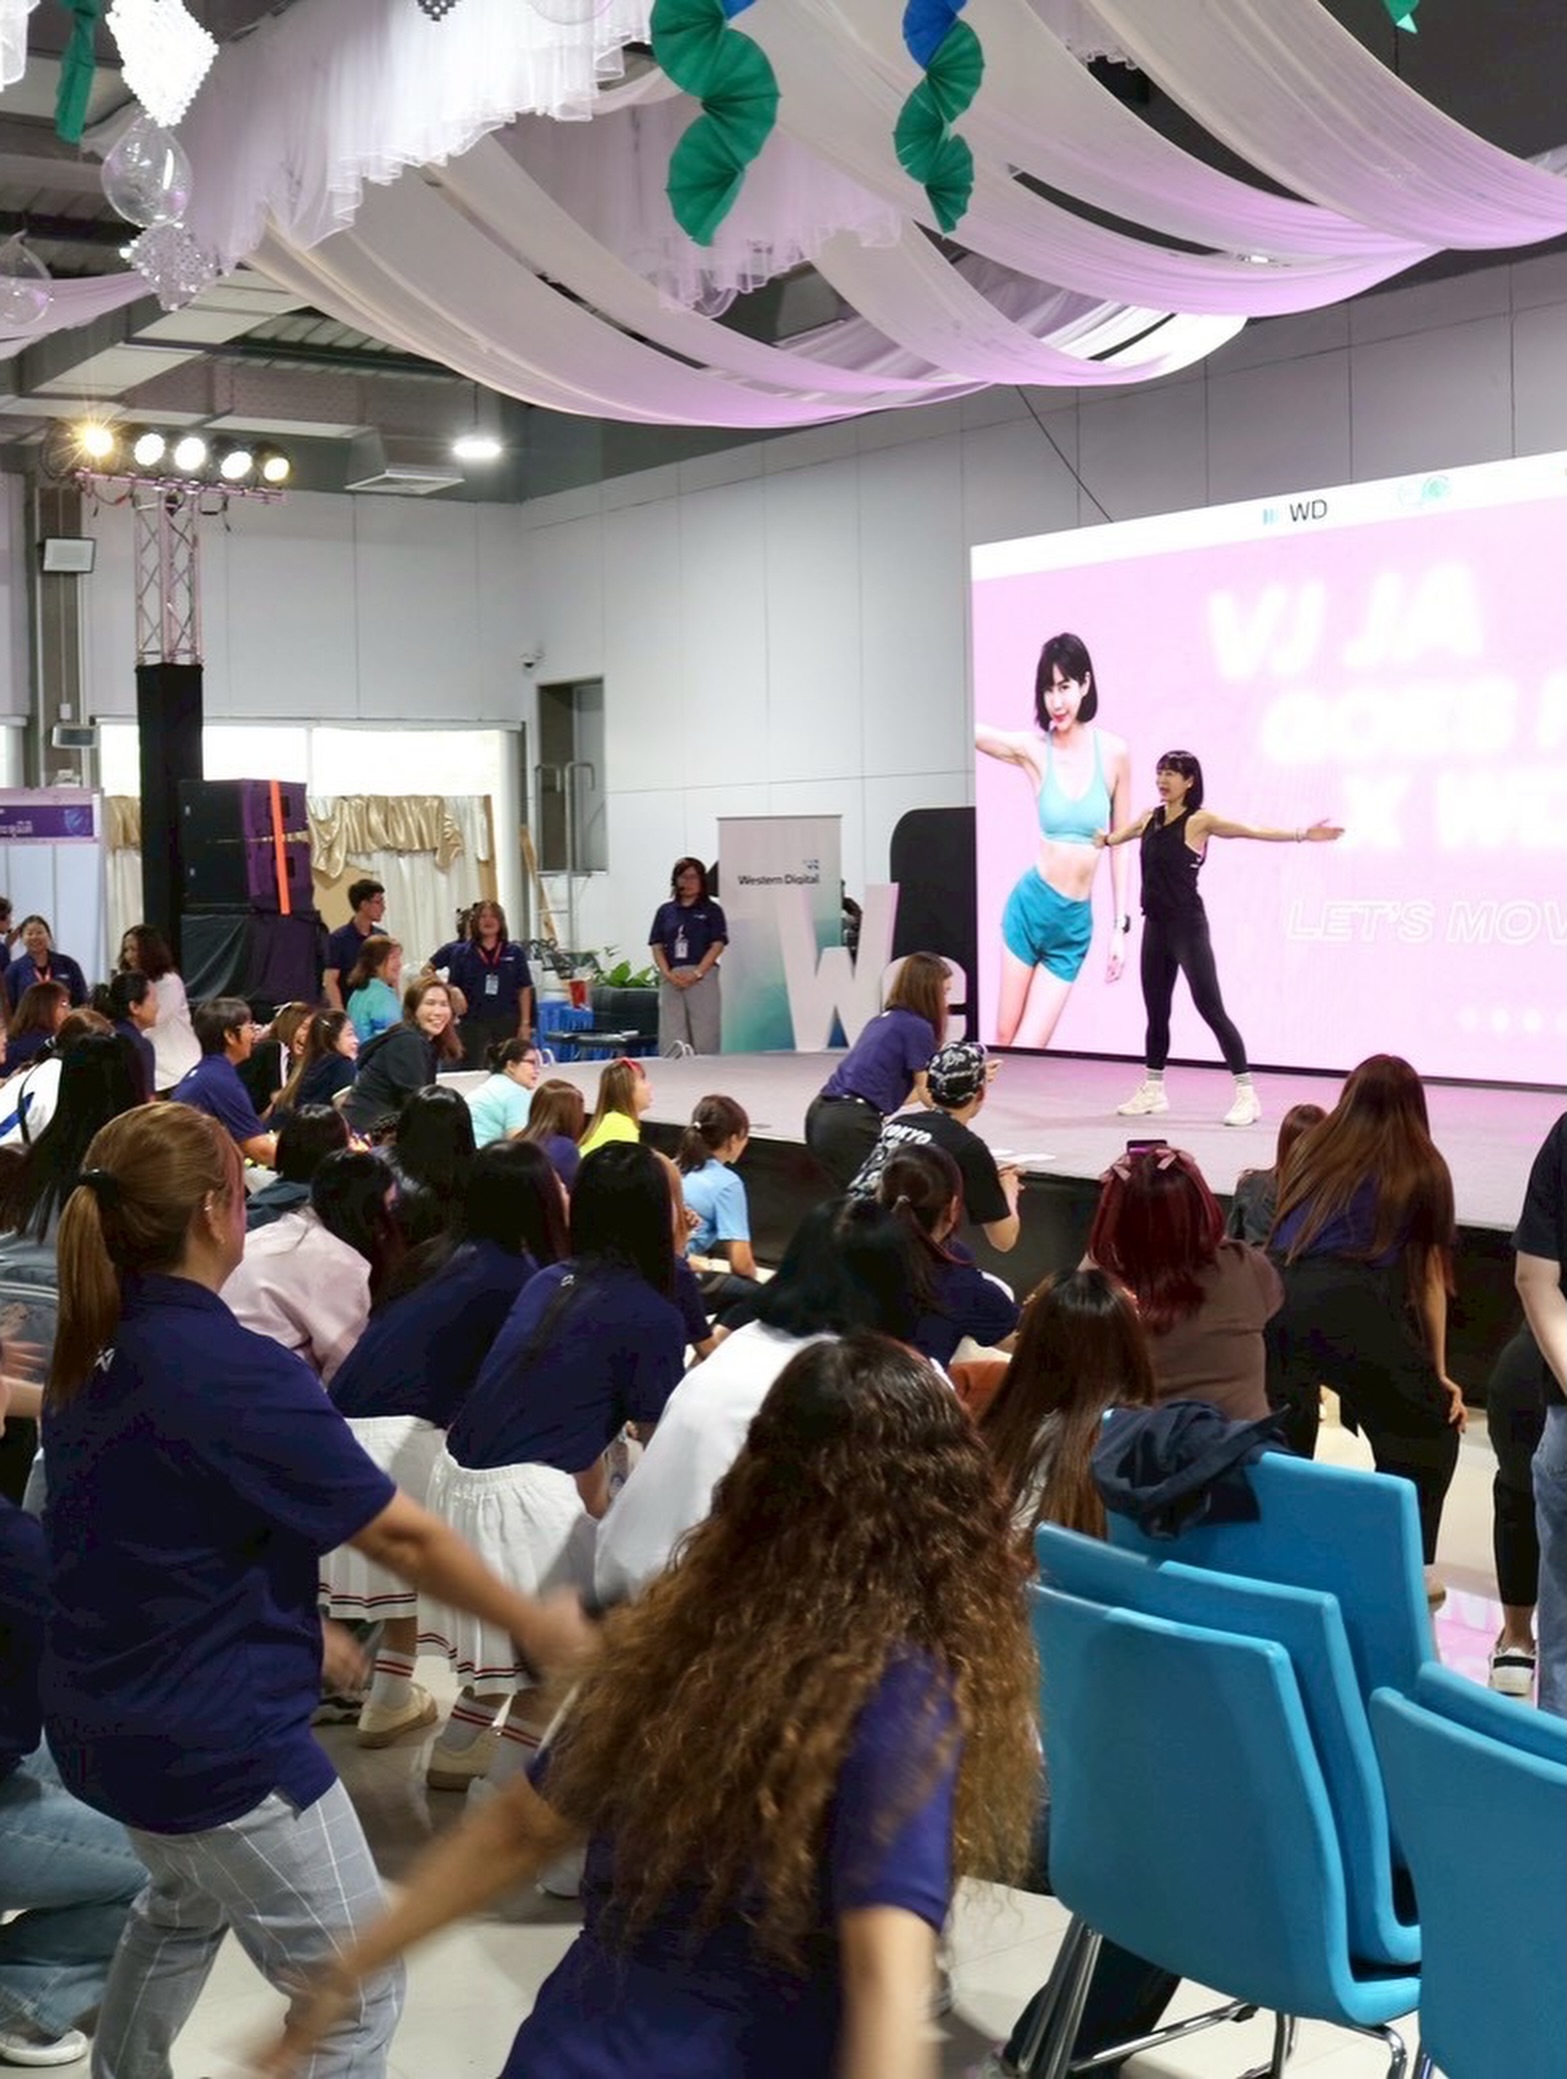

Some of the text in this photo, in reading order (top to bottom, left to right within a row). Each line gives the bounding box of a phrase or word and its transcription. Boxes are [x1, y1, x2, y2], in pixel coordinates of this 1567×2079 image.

[1289, 499, 1328, 522] WD
[1209, 562, 1485, 678] VJ JA
[737, 874, 819, 885] Western Digital
